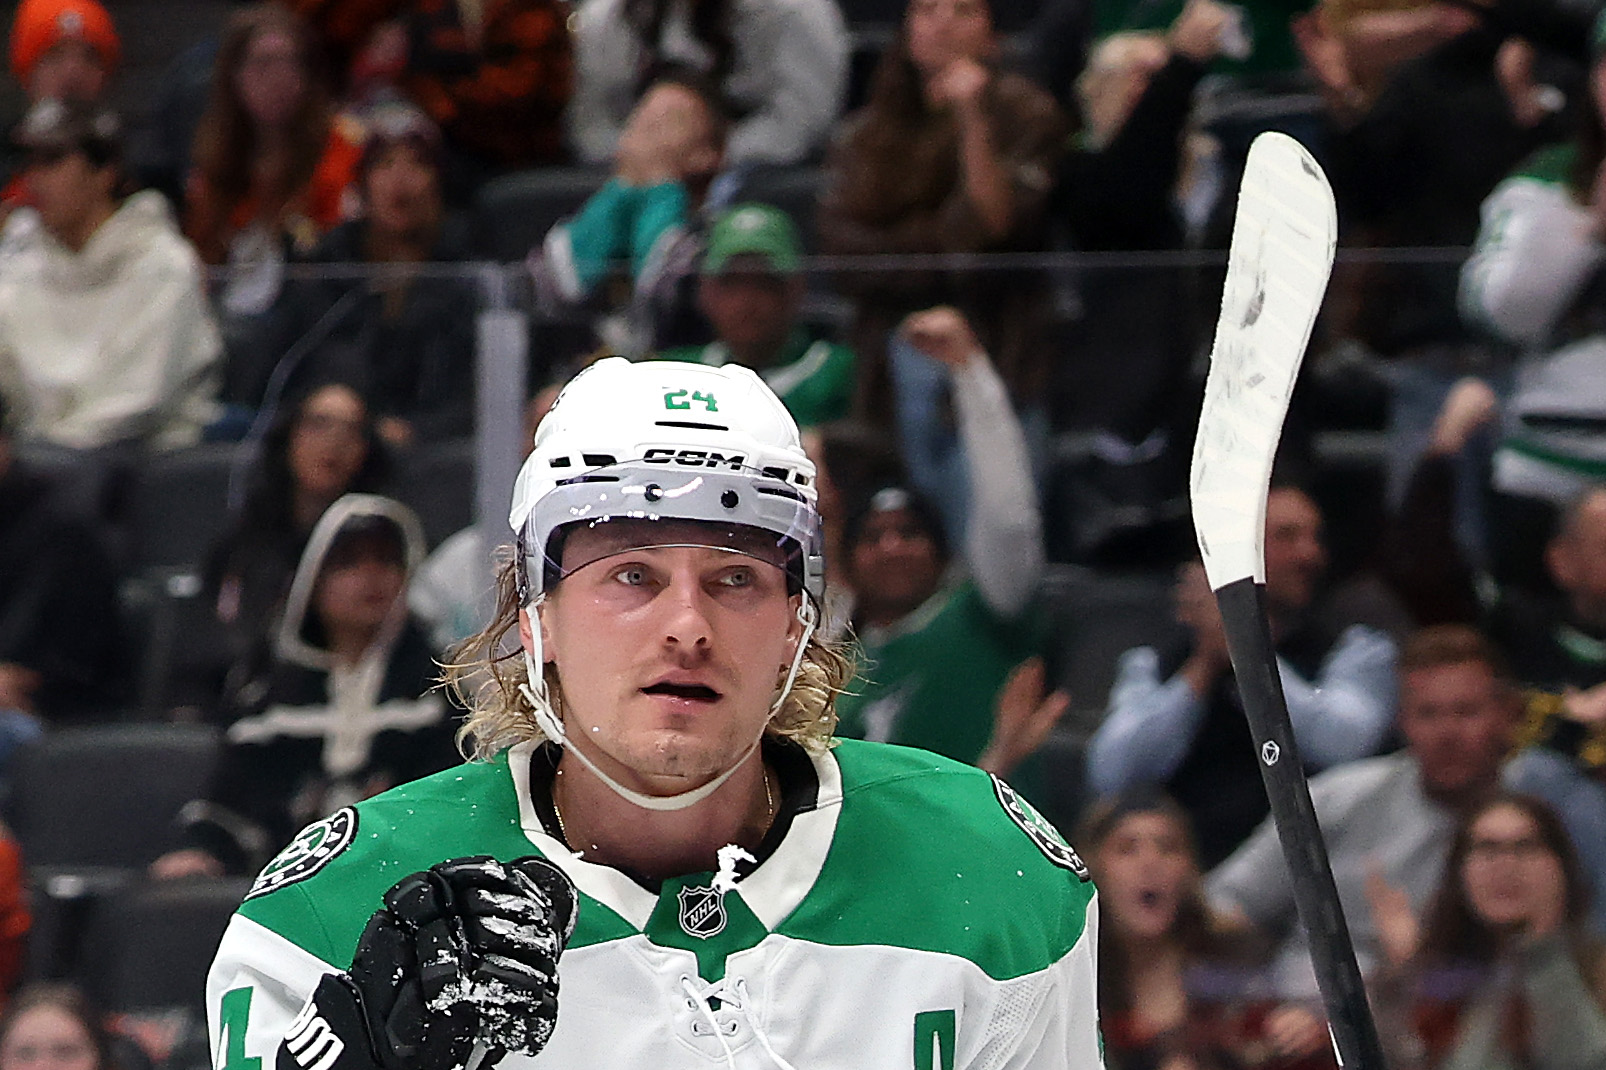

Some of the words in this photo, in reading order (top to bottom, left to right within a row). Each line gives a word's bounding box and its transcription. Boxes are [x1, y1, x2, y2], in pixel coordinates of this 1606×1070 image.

[662, 387, 719, 413] 24
[643, 448, 747, 471] CCM
[689, 898, 717, 928] NHL
